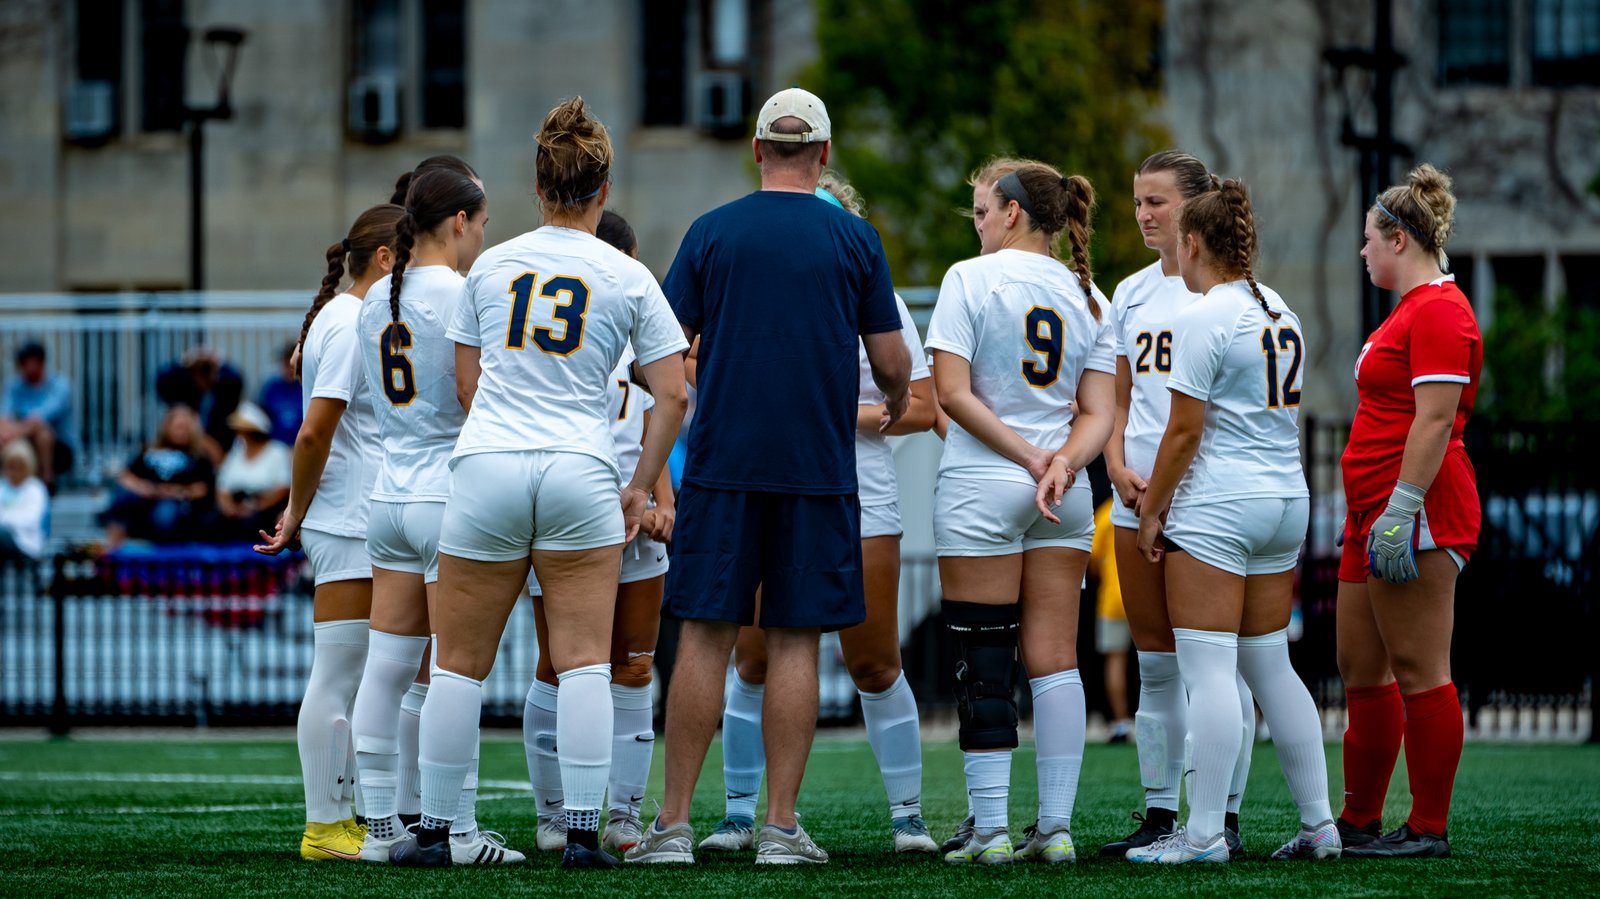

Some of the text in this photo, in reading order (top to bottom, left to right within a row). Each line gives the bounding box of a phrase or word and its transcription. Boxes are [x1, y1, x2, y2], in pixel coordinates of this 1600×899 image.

[505, 271, 592, 357] 13
[1021, 305, 1065, 388] 9
[1136, 330, 1172, 375] 26
[379, 321, 417, 407] 6
[1260, 326, 1302, 409] 12
